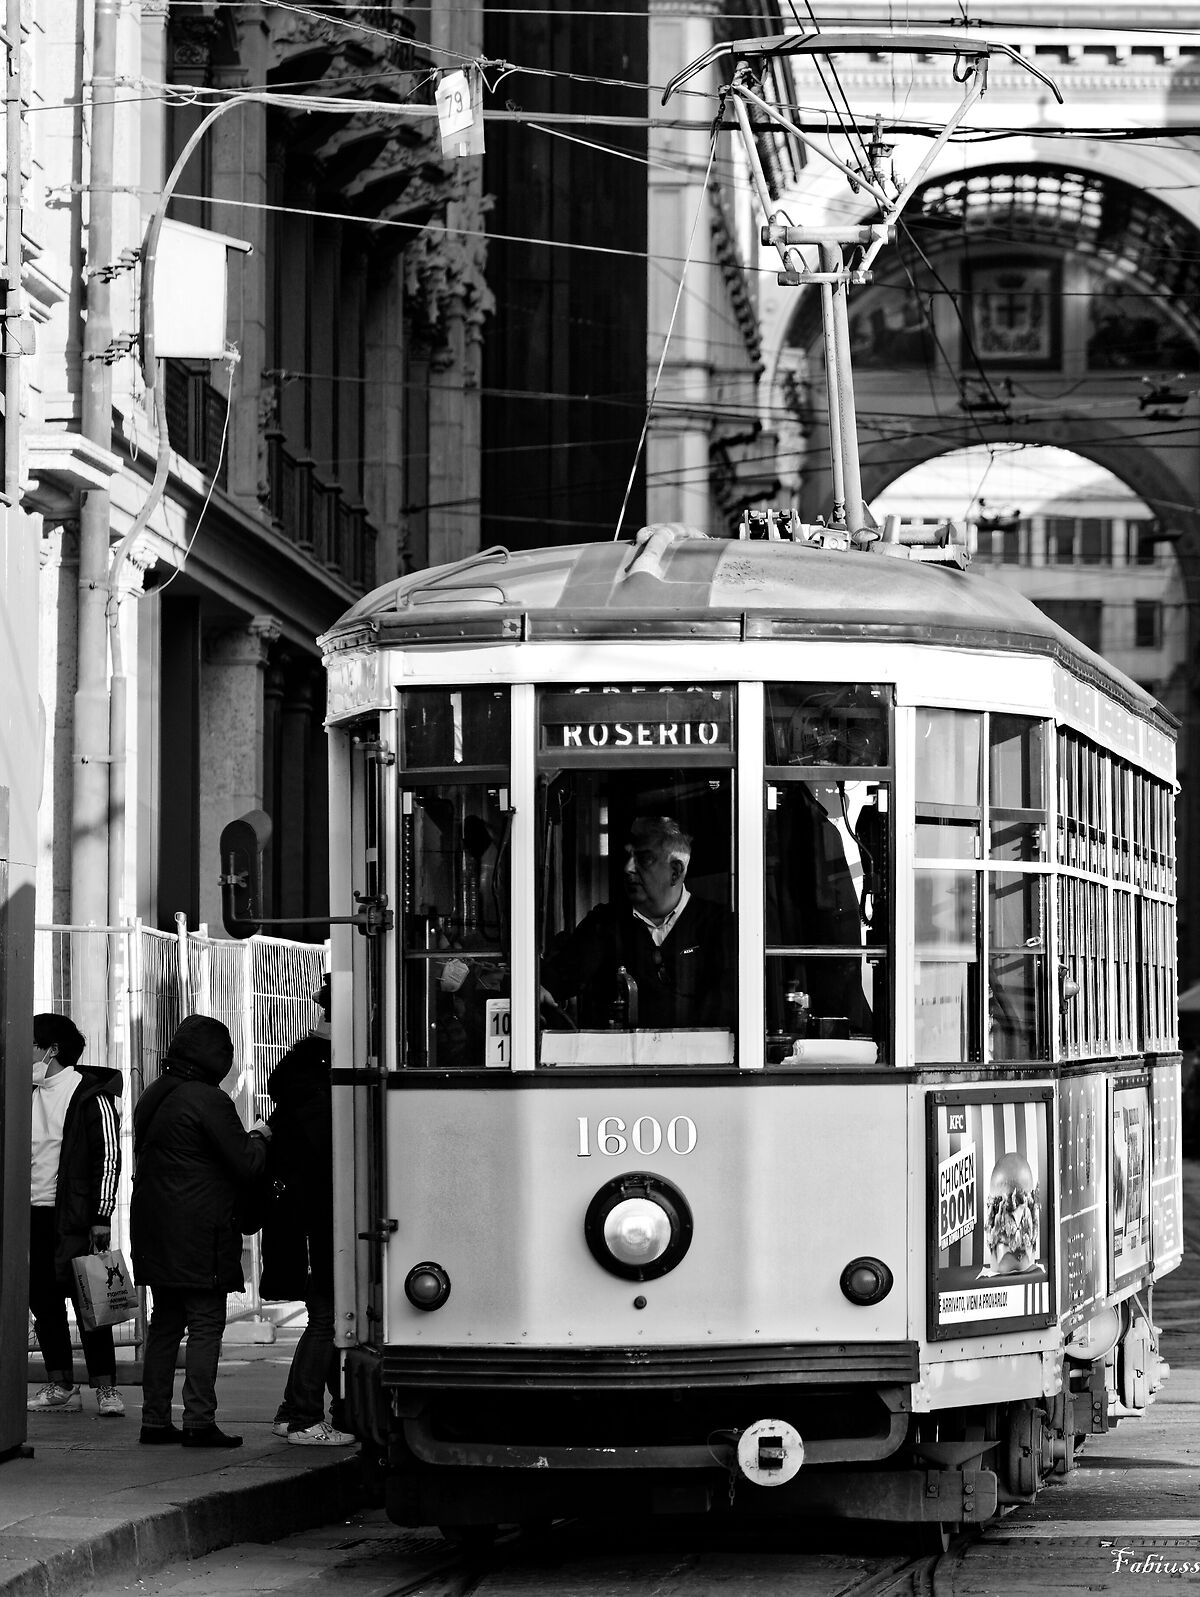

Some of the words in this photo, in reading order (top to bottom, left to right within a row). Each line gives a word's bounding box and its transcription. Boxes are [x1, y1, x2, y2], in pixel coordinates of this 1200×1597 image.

[445, 91, 463, 118] 79
[563, 722, 719, 747] ROSERIO
[492, 1012, 511, 1035] 10
[497, 1039, 504, 1062] 1
[949, 1114, 964, 1130] KFC
[576, 1115, 698, 1157] 1600
[940, 1152, 975, 1198] CHICKEN
[940, 1181, 975, 1237] BOOM
